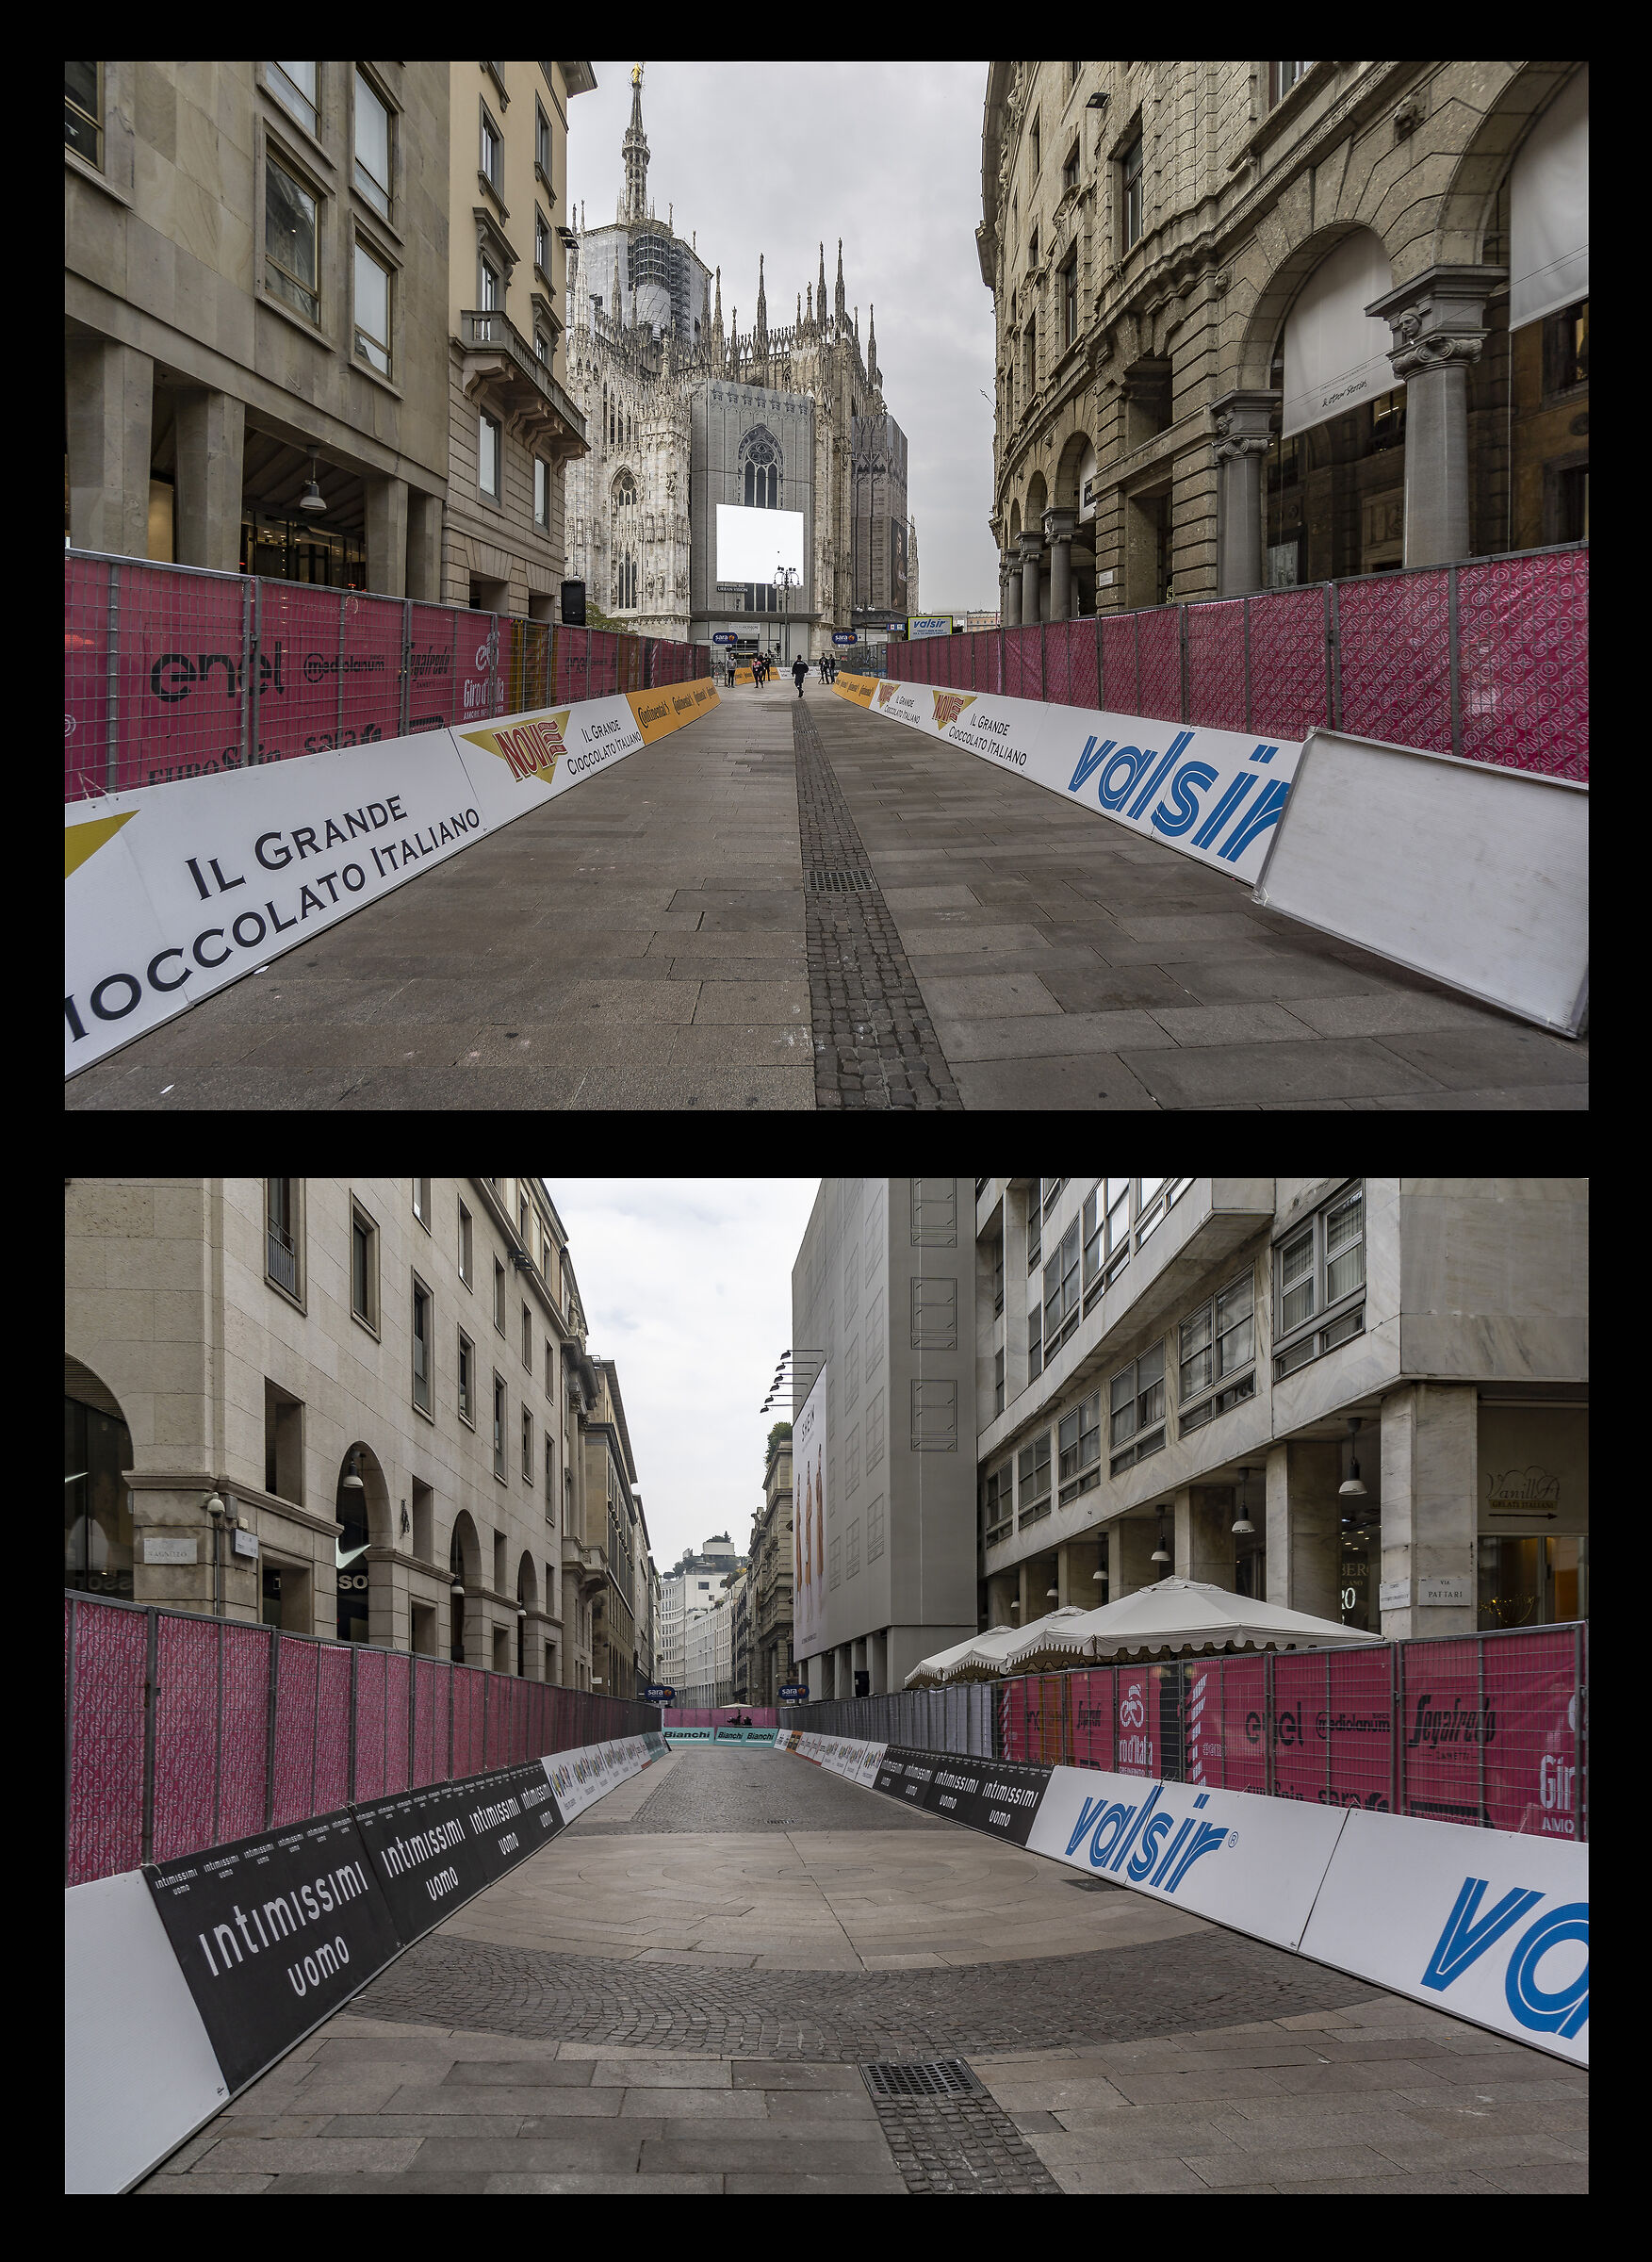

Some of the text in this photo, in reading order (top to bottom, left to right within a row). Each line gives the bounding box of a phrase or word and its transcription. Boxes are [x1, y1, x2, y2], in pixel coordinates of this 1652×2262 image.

[913, 618, 946, 629] valsir
[903, 707, 921, 724] ITALIANO
[932, 694, 953, 723] NOVI
[581, 728, 592, 743] IL
[591, 719, 621, 740] GRANDE
[970, 713, 1010, 736] IL GRANDE
[493, 723, 554, 783] NOVI
[567, 731, 642, 775] CIOCCOLATO ITALIANO
[949, 726, 1027, 766] CIOCCOLATO ITALIANO
[1068, 731, 1291, 863] valsir
[185, 795, 409, 901] IL GRANDE
[65, 808, 482, 1042] IOCCOLATO ITALIANO
[338, 1574, 368, 1590] SO
[717, 1731, 744, 1740] Bianchi
[746, 1732, 775, 1741] Bianchi
[1246, 1701, 1304, 1747] eel
[935, 1770, 979, 1794] intimissimi
[982, 1780, 1039, 1809] intimissimi
[939, 1794, 957, 1810] uomo
[469, 1796, 521, 1835] intimissimi
[989, 1809, 1011, 1828] uomo
[1542, 1816, 1576, 1834] AMO
[244, 1843, 274, 1859] intimissimi
[381, 1818, 466, 1878] intimissimi
[498, 1831, 519, 1856] uomo
[1065, 1785, 1230, 1893] valsir
[204, 1855, 239, 1873] intimissimi
[219, 1869, 234, 1878] uomo
[155, 1868, 198, 1890] intimissimi
[172, 1884, 190, 1895] uomo
[426, 1866, 459, 1901] uomo
[199, 1860, 368, 1976] intimissimi
[287, 1936, 350, 1997] uomo
[1421, 1877, 1589, 2040] va
